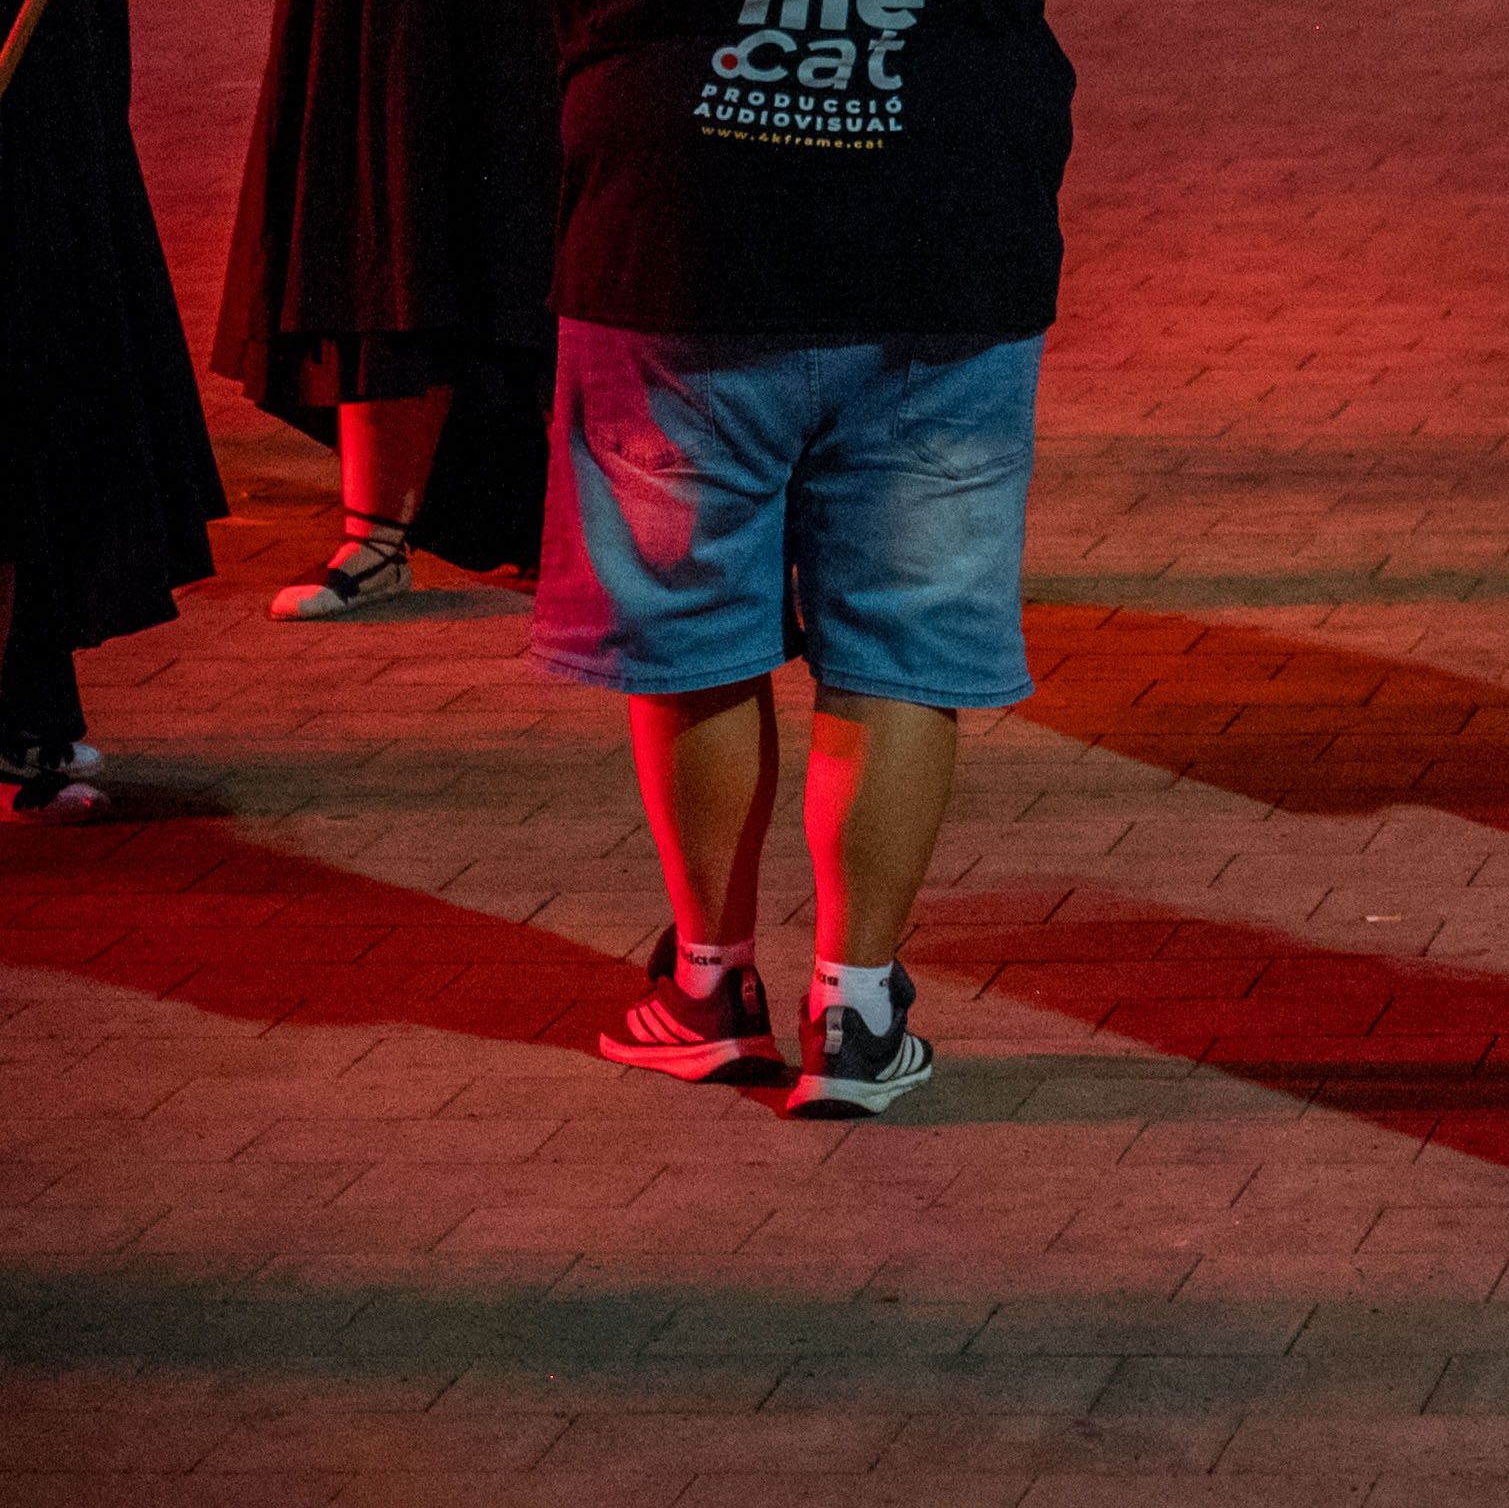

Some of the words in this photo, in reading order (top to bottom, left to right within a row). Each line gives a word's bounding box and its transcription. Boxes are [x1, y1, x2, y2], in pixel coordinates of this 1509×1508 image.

[700, 83, 903, 114] PRODUCCIÓ
[693, 102, 903, 132] AUDIOVISUAL
[701, 126, 885, 150] www.4kframe.cat
